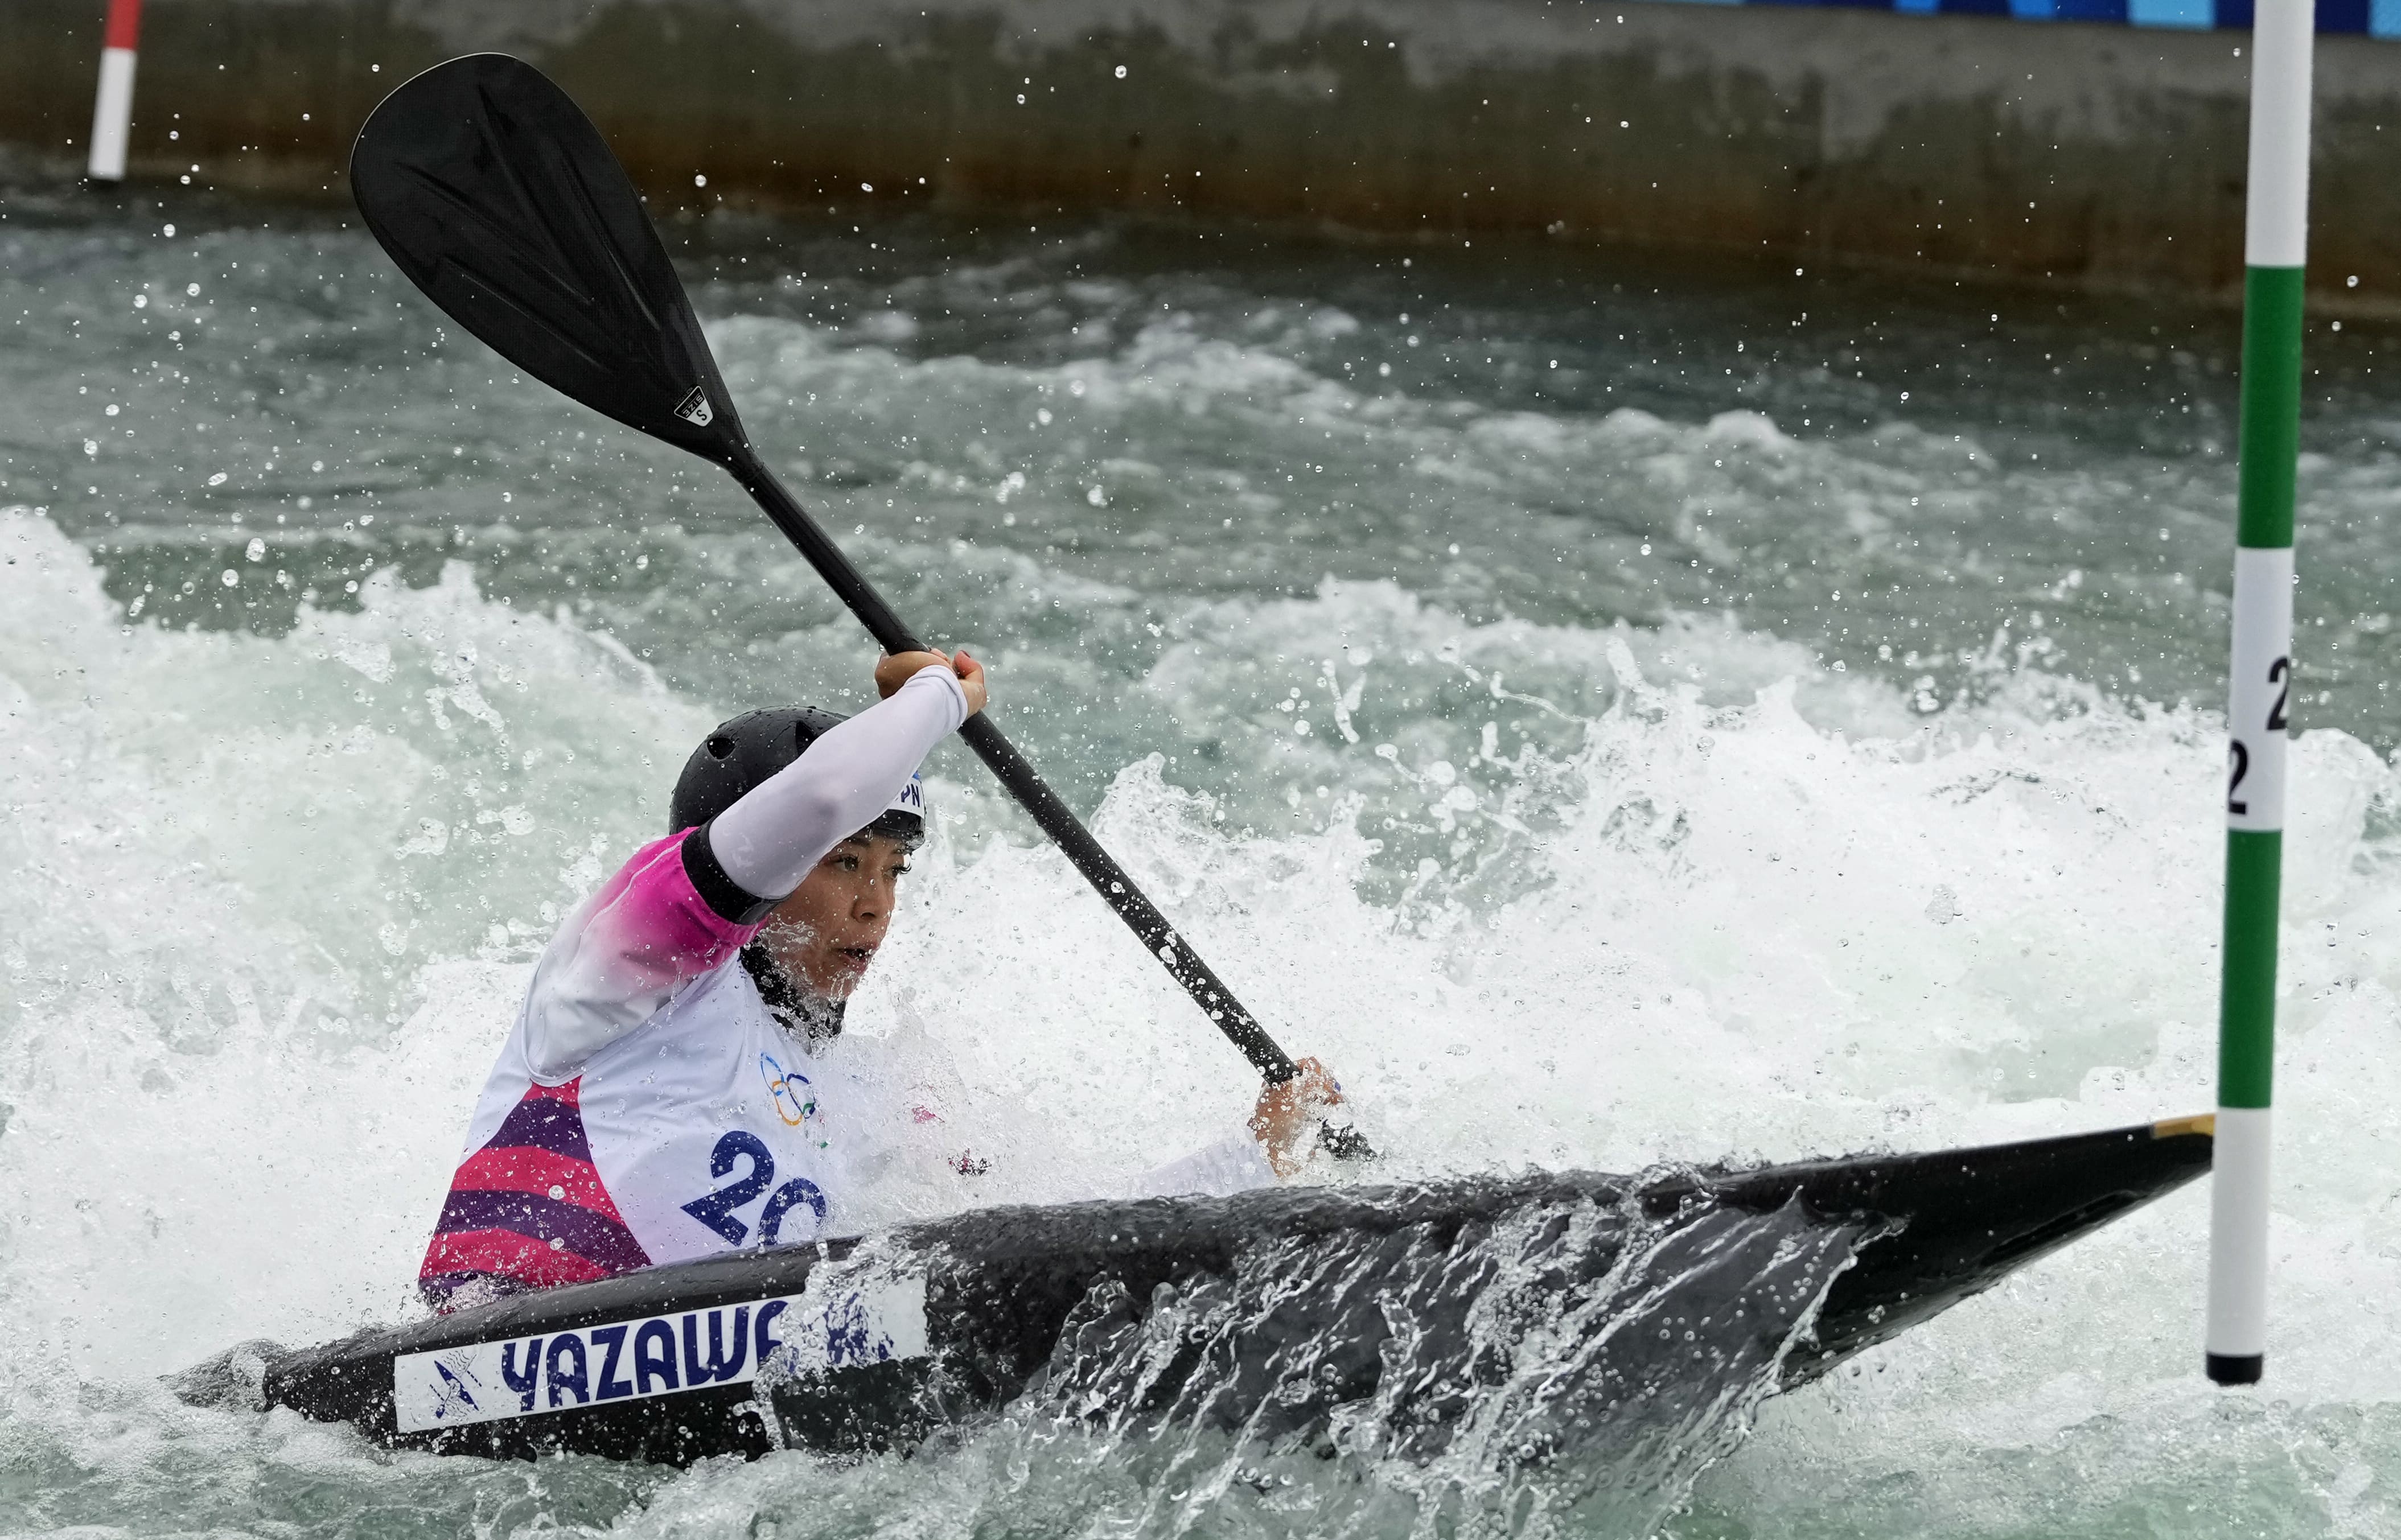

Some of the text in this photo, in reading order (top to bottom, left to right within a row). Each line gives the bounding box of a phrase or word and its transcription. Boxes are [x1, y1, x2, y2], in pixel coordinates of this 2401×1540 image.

[683, 395, 704, 418] SIZE
[697, 410, 707, 421] S
[2266, 656, 2288, 730] 2
[2229, 739, 2248, 814] 2
[895, 784, 920, 807] PN
